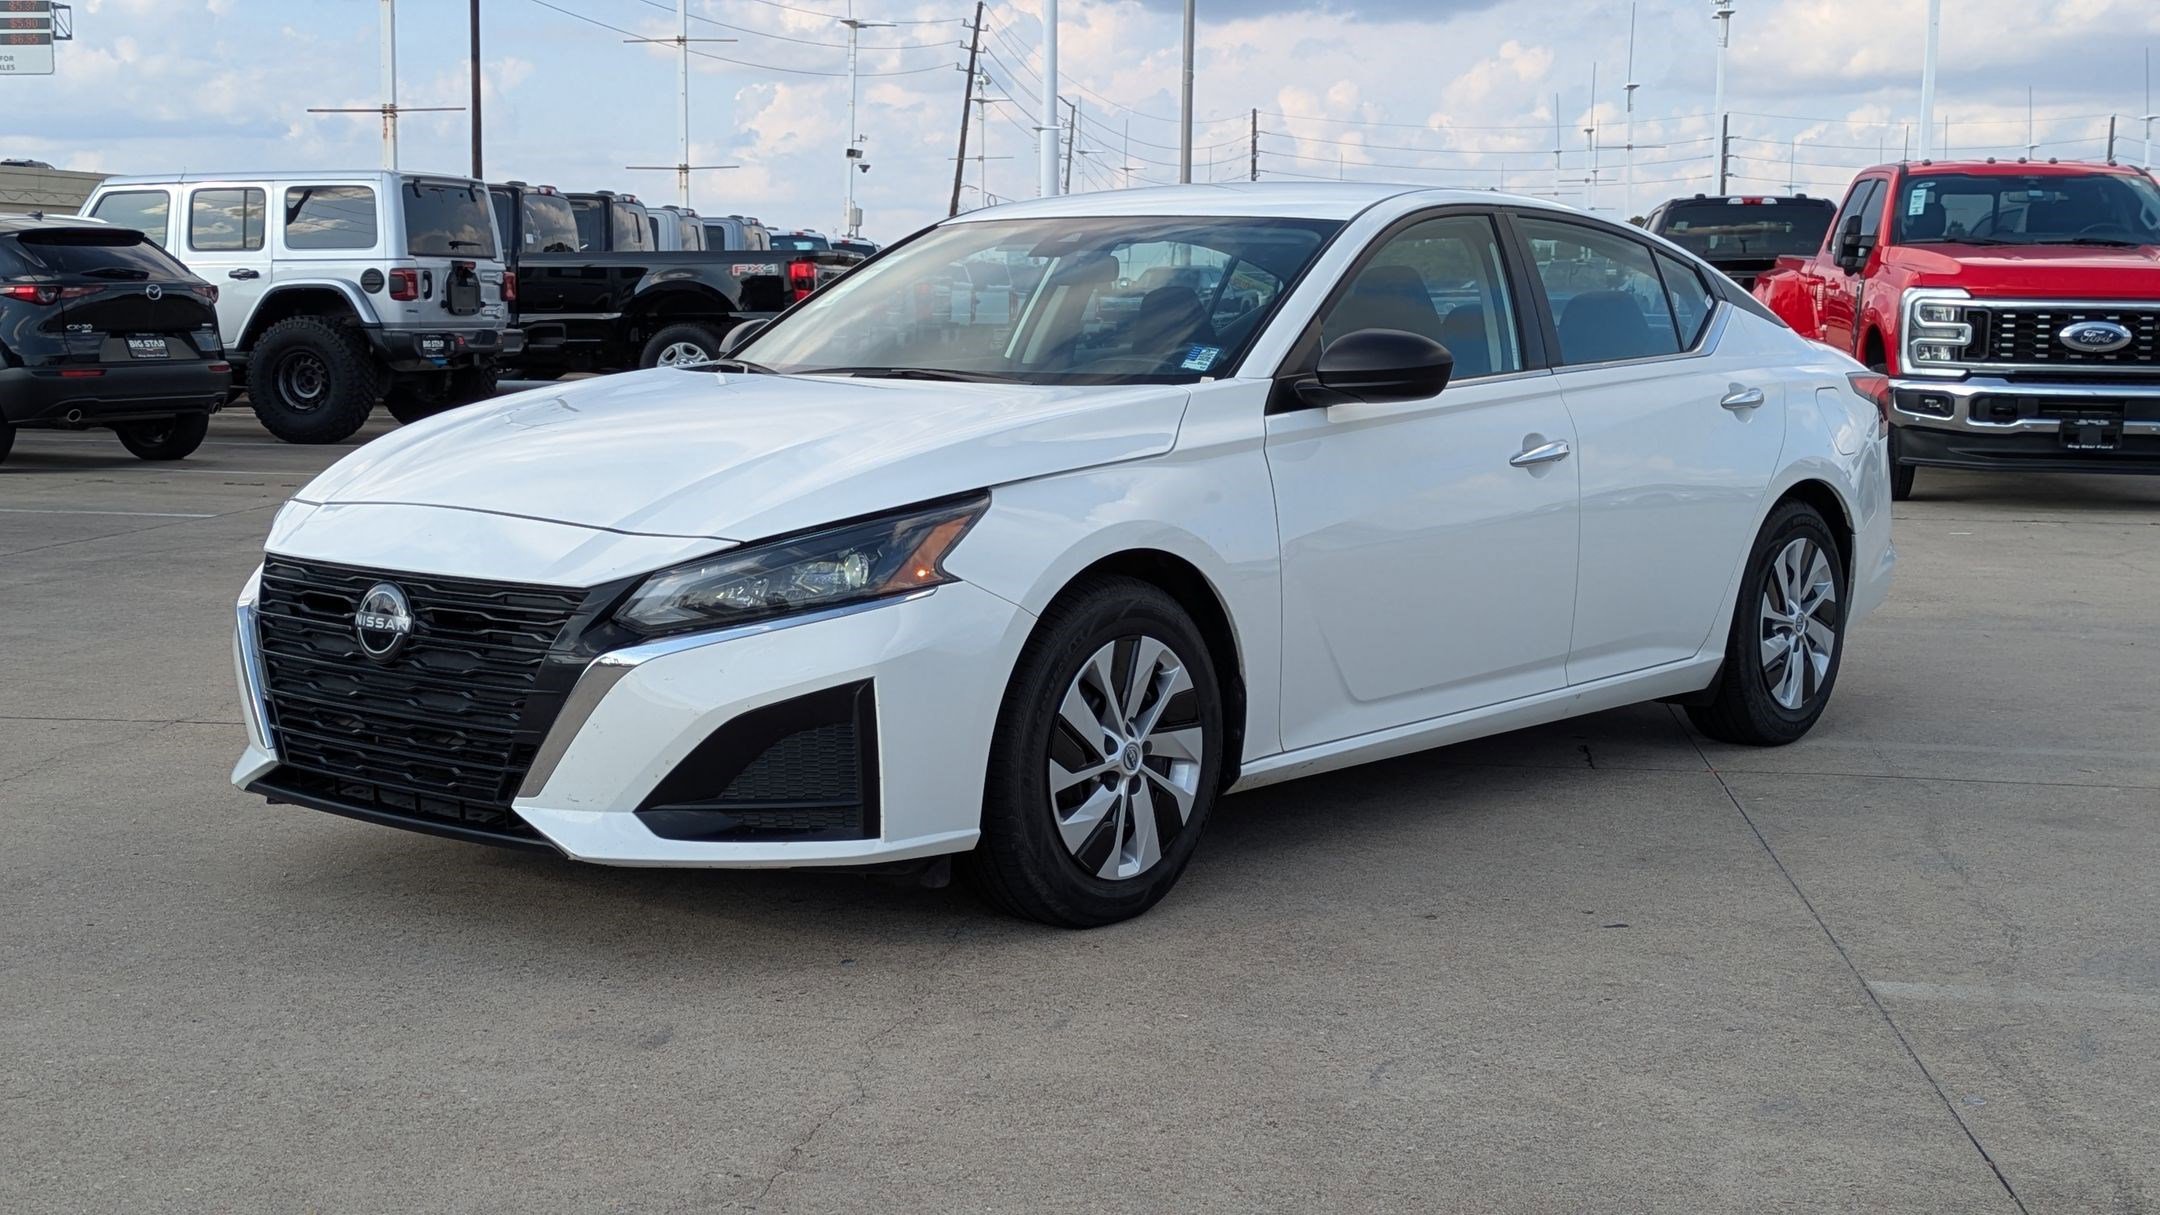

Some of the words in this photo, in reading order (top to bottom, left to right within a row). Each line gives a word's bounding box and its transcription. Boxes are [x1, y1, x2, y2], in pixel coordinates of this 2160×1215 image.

[732, 263, 778, 276] FX4
[2080, 329, 2113, 343] Ford
[354, 613, 409, 632] NISSAN
